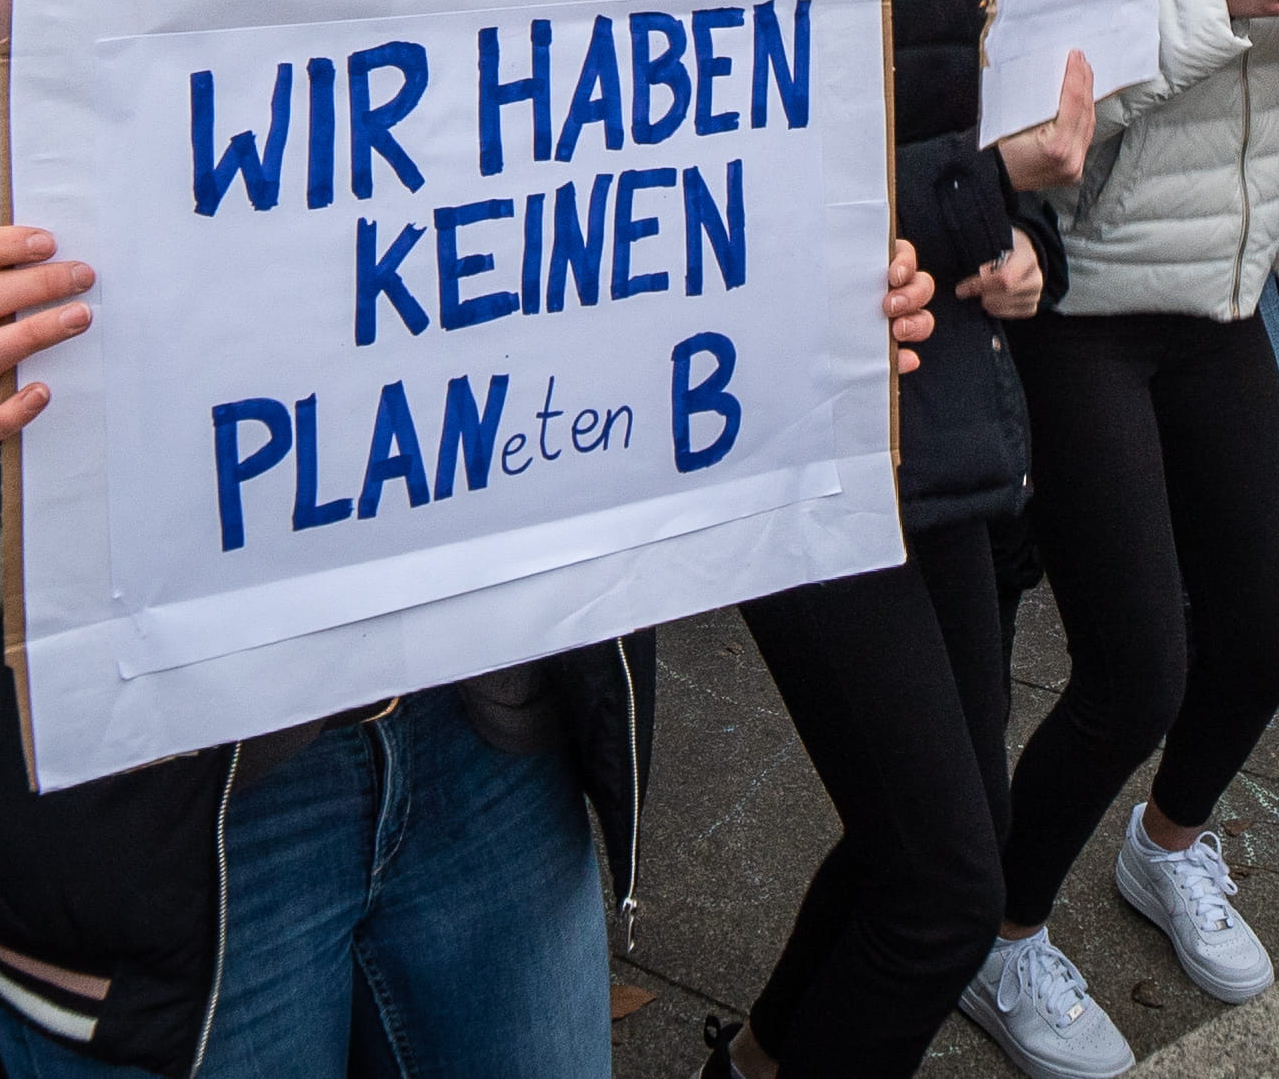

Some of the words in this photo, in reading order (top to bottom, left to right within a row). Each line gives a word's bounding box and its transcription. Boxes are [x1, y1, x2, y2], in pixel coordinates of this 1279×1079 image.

[189, 40, 429, 217] WIR
[354, 158, 747, 347] KEINEN
[212, 373, 633, 552] PLANeten
[668, 330, 743, 473] B
